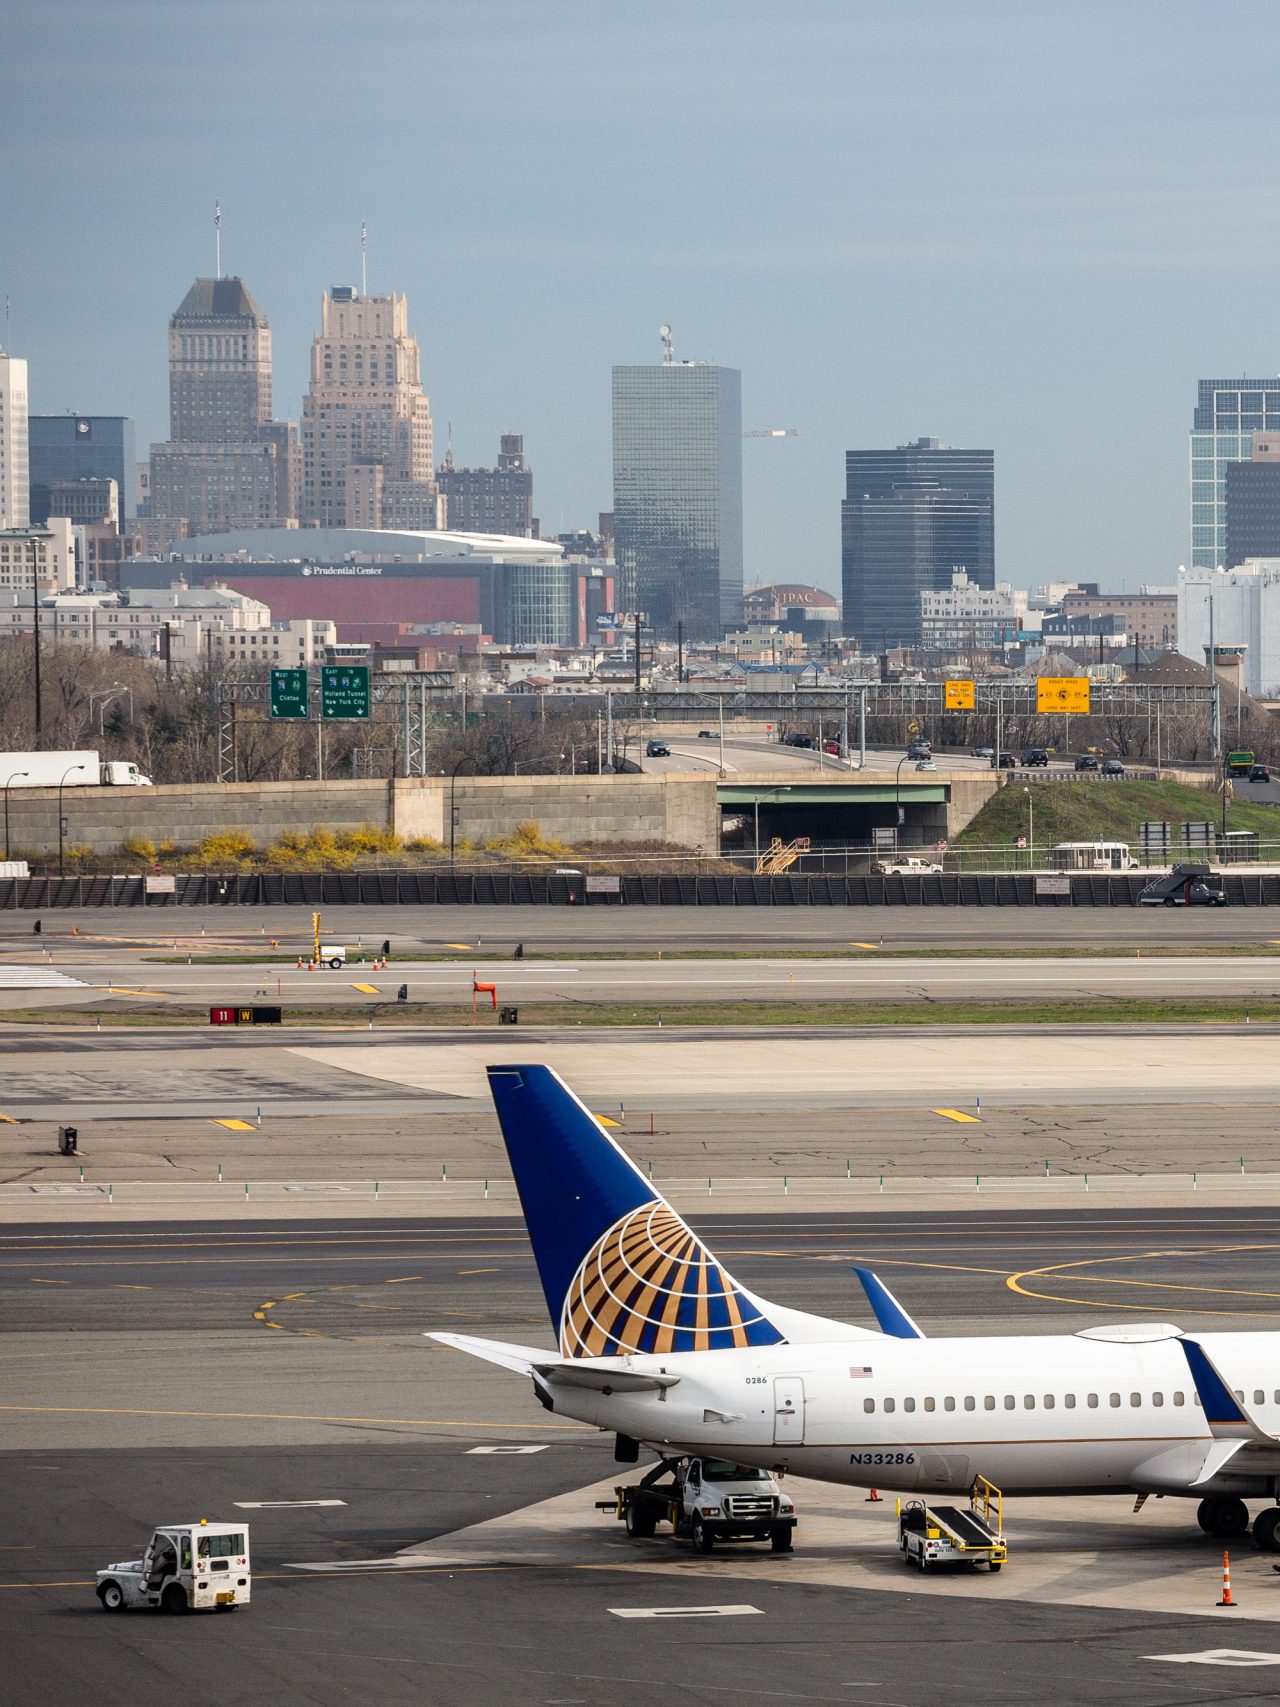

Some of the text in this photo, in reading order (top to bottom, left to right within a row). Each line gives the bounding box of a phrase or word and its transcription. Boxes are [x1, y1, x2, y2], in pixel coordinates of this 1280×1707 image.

[313, 566, 383, 575] Prudential Center
[353, 698, 365, 707] City
[219, 1011, 228, 1021] 11
[241, 1011, 250, 1021] W
[849, 1453, 915, 1465] N33286
